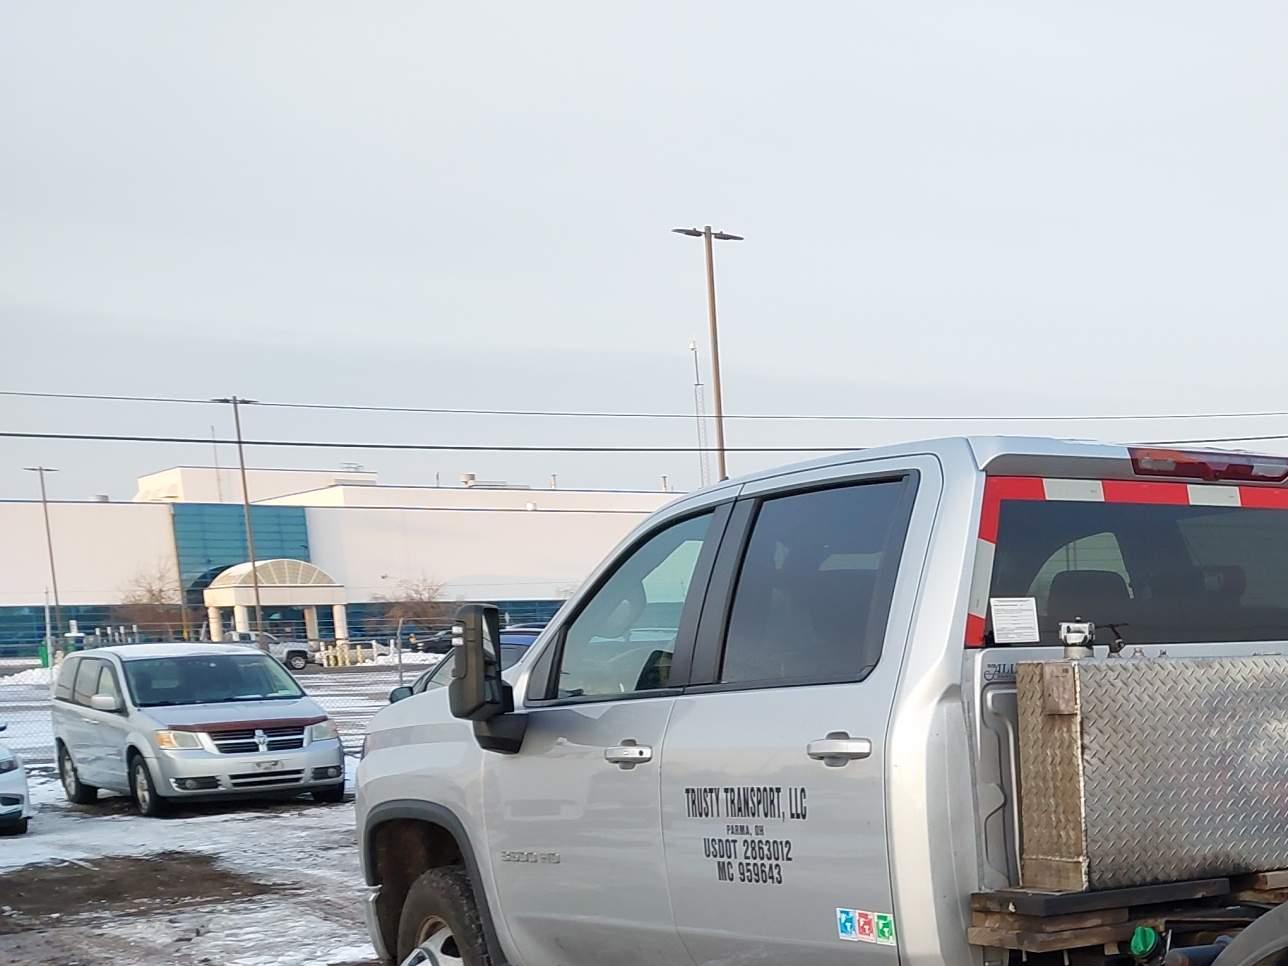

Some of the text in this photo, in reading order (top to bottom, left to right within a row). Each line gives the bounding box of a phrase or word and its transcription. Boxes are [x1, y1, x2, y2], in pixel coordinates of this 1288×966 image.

[685, 786, 807, 822] TRUSTY TRANSPORT, LLC
[726, 825, 765, 836] PARMA, OH
[703, 837, 793, 861] USDOT 2863012
[717, 861, 783, 885] MC 959643
